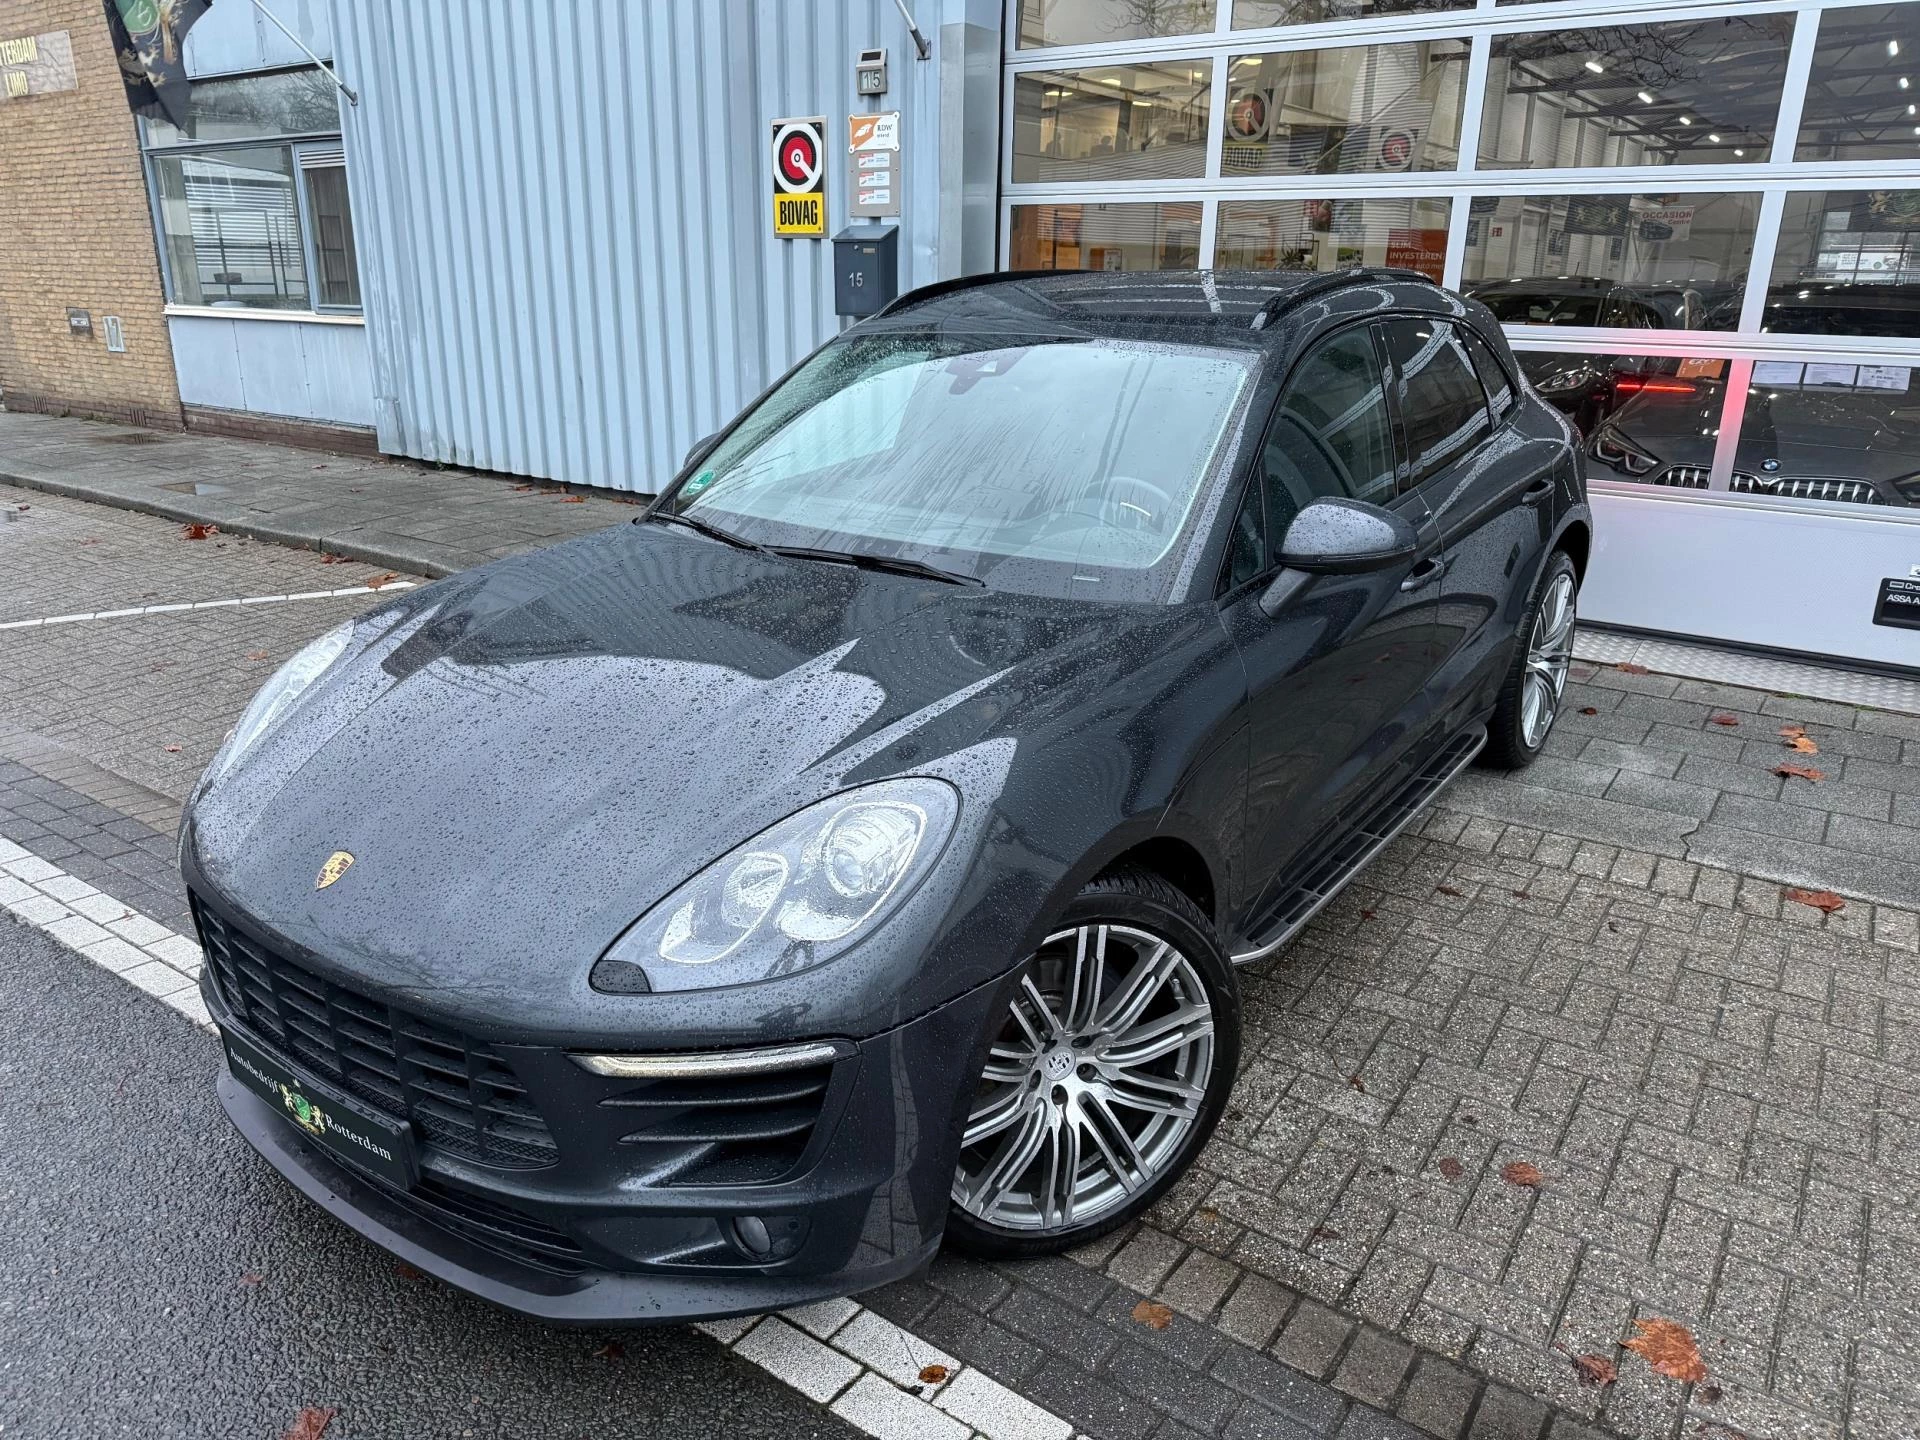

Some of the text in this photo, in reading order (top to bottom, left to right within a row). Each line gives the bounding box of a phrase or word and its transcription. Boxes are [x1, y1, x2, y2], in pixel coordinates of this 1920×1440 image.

[863, 71, 881, 88] 15
[877, 124, 893, 132] RDW
[779, 200, 818, 226] BOVAG
[1642, 211, 1692, 219] OCCASION
[849, 272, 864, 288] 15
[1886, 594, 1912, 604] ASSA
[230, 1047, 393, 1161] Autobedrijf Rotterdam
